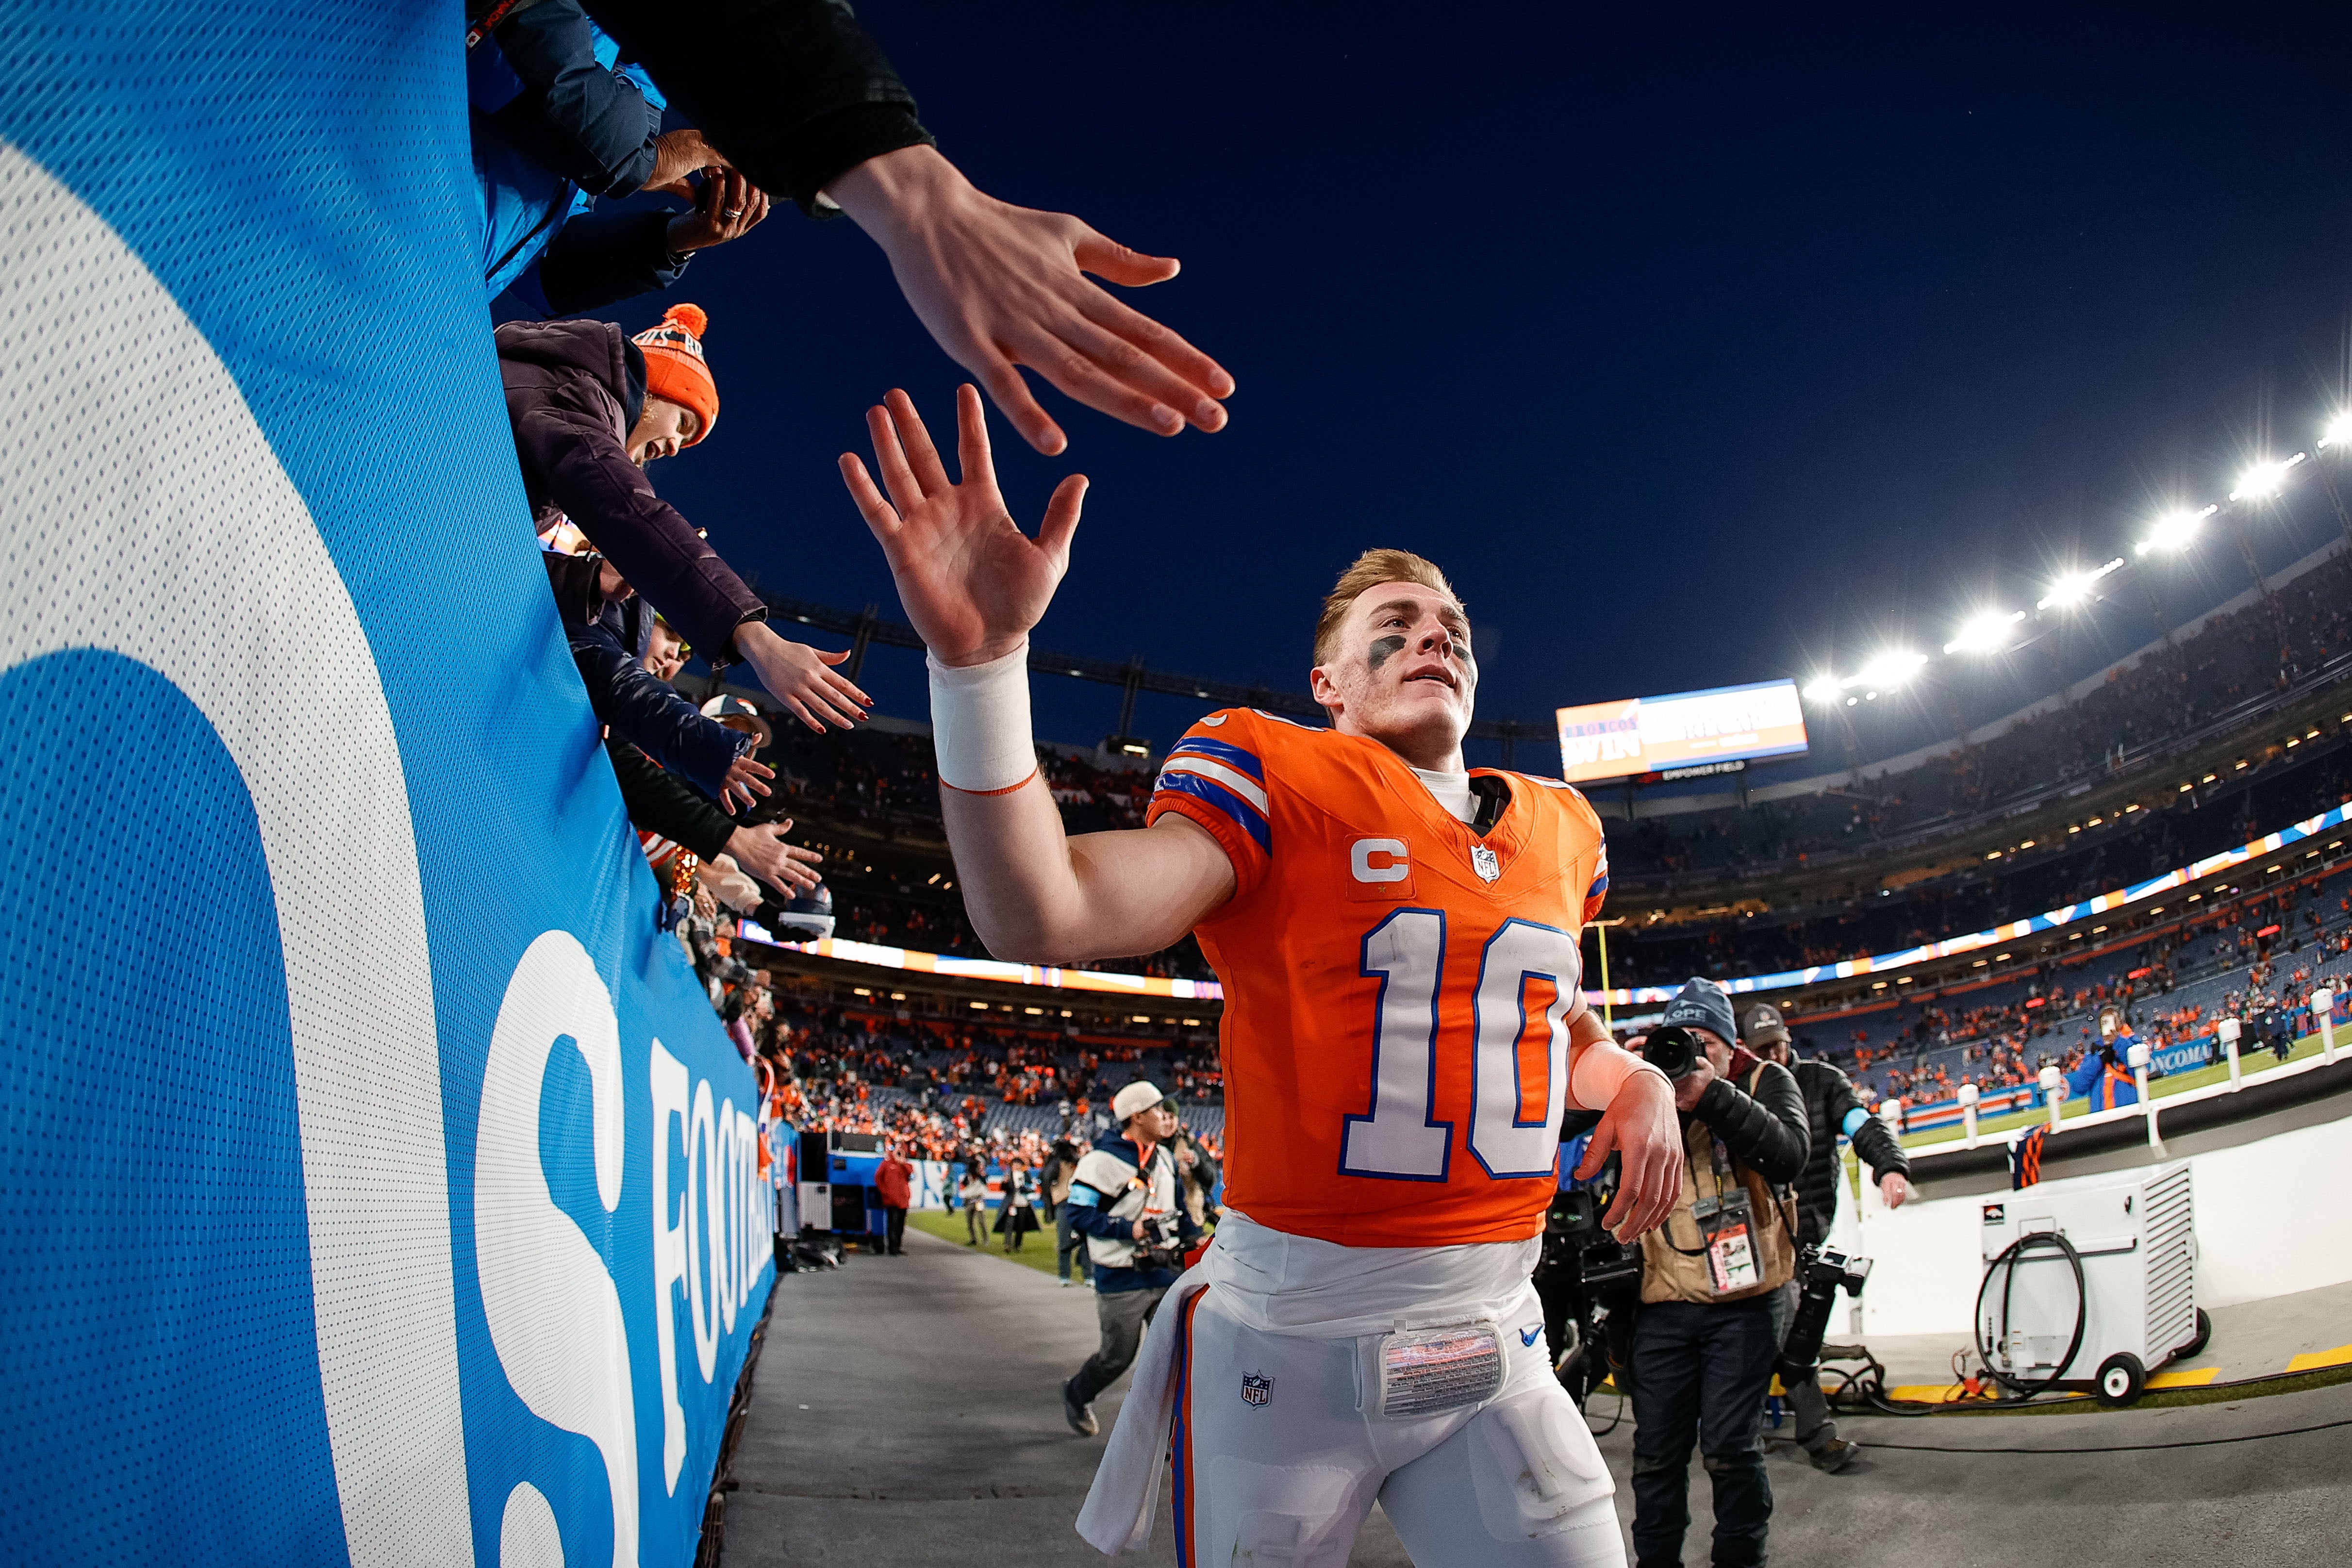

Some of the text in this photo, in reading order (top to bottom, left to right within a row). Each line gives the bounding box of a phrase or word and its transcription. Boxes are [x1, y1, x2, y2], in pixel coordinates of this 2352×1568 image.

[1565, 717, 1637, 738] BRONCOS
[1560, 729, 1640, 767] WIN
[1351, 838, 1408, 883] C
[1477, 859, 1495, 875] NFL
[1338, 906, 1582, 1183] 10
[1244, 1386, 1266, 1403] NFL
